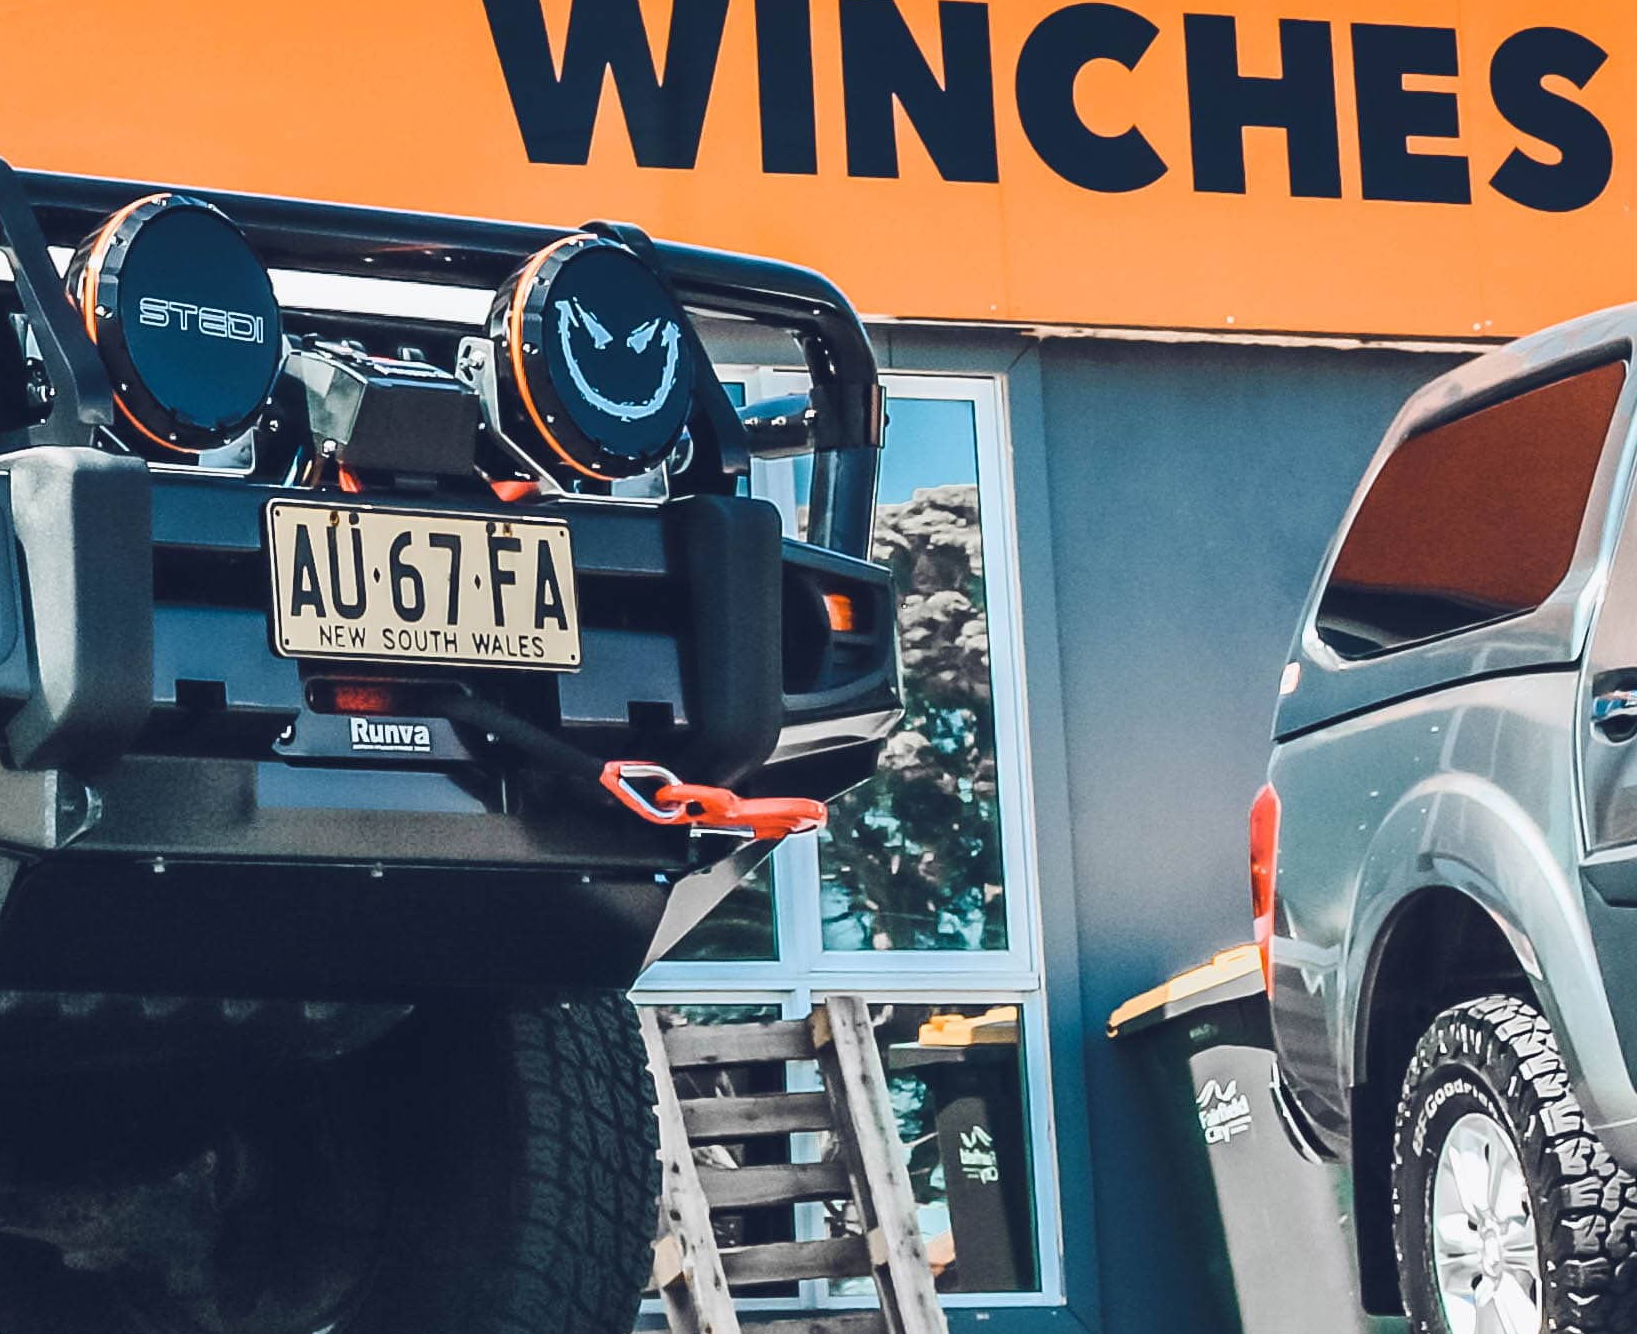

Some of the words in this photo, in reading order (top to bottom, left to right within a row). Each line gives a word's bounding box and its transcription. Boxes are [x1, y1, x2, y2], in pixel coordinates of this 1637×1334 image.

[139, 297, 264, 343] STEDI
[319, 625, 367, 648] NEW
[382, 628, 458, 654] SOUTH
[472, 632, 545, 658] WALES
[350, 717, 431, 745] Runva
